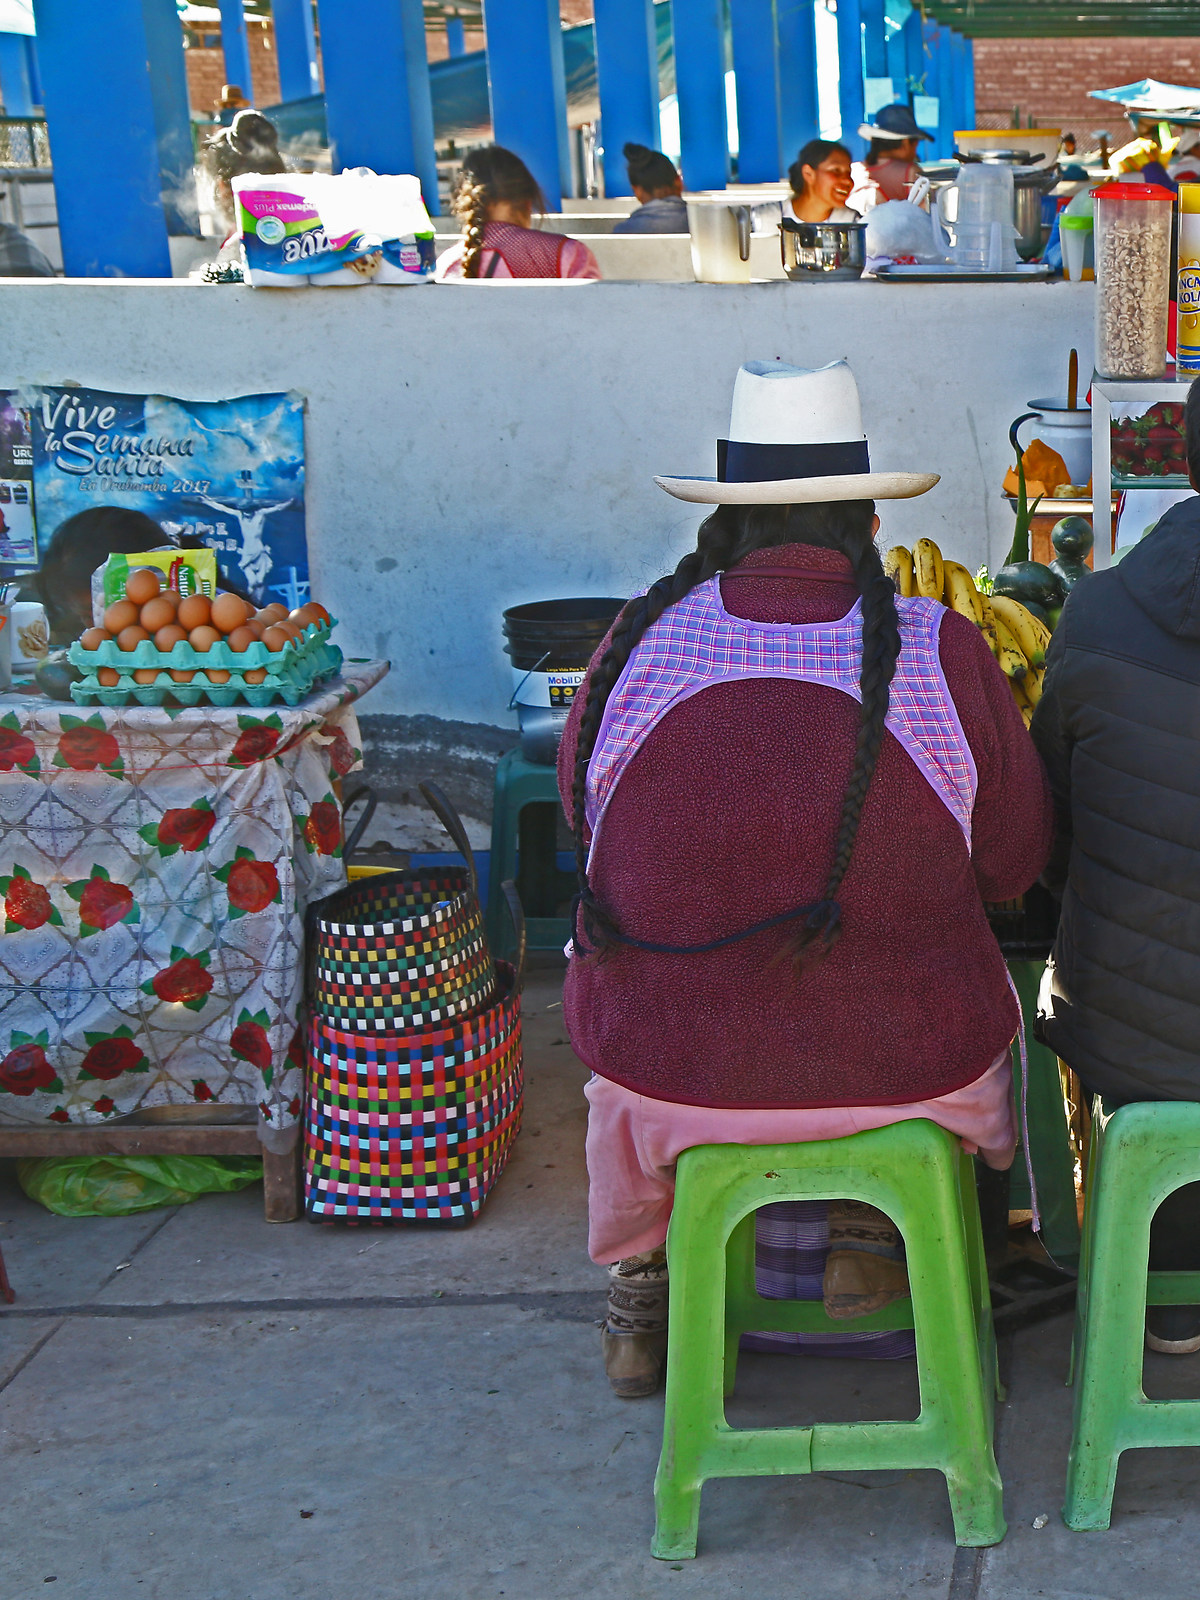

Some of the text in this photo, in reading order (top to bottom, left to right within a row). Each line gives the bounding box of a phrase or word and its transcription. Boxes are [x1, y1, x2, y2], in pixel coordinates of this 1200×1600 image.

[253, 203, 275, 213] Plus
[41, 393, 116, 431] Vive
[44, 430, 195, 473] la Semana
[79, 477, 212, 493] En Urubamba 2017
[548, 676, 573, 685] Mobil
